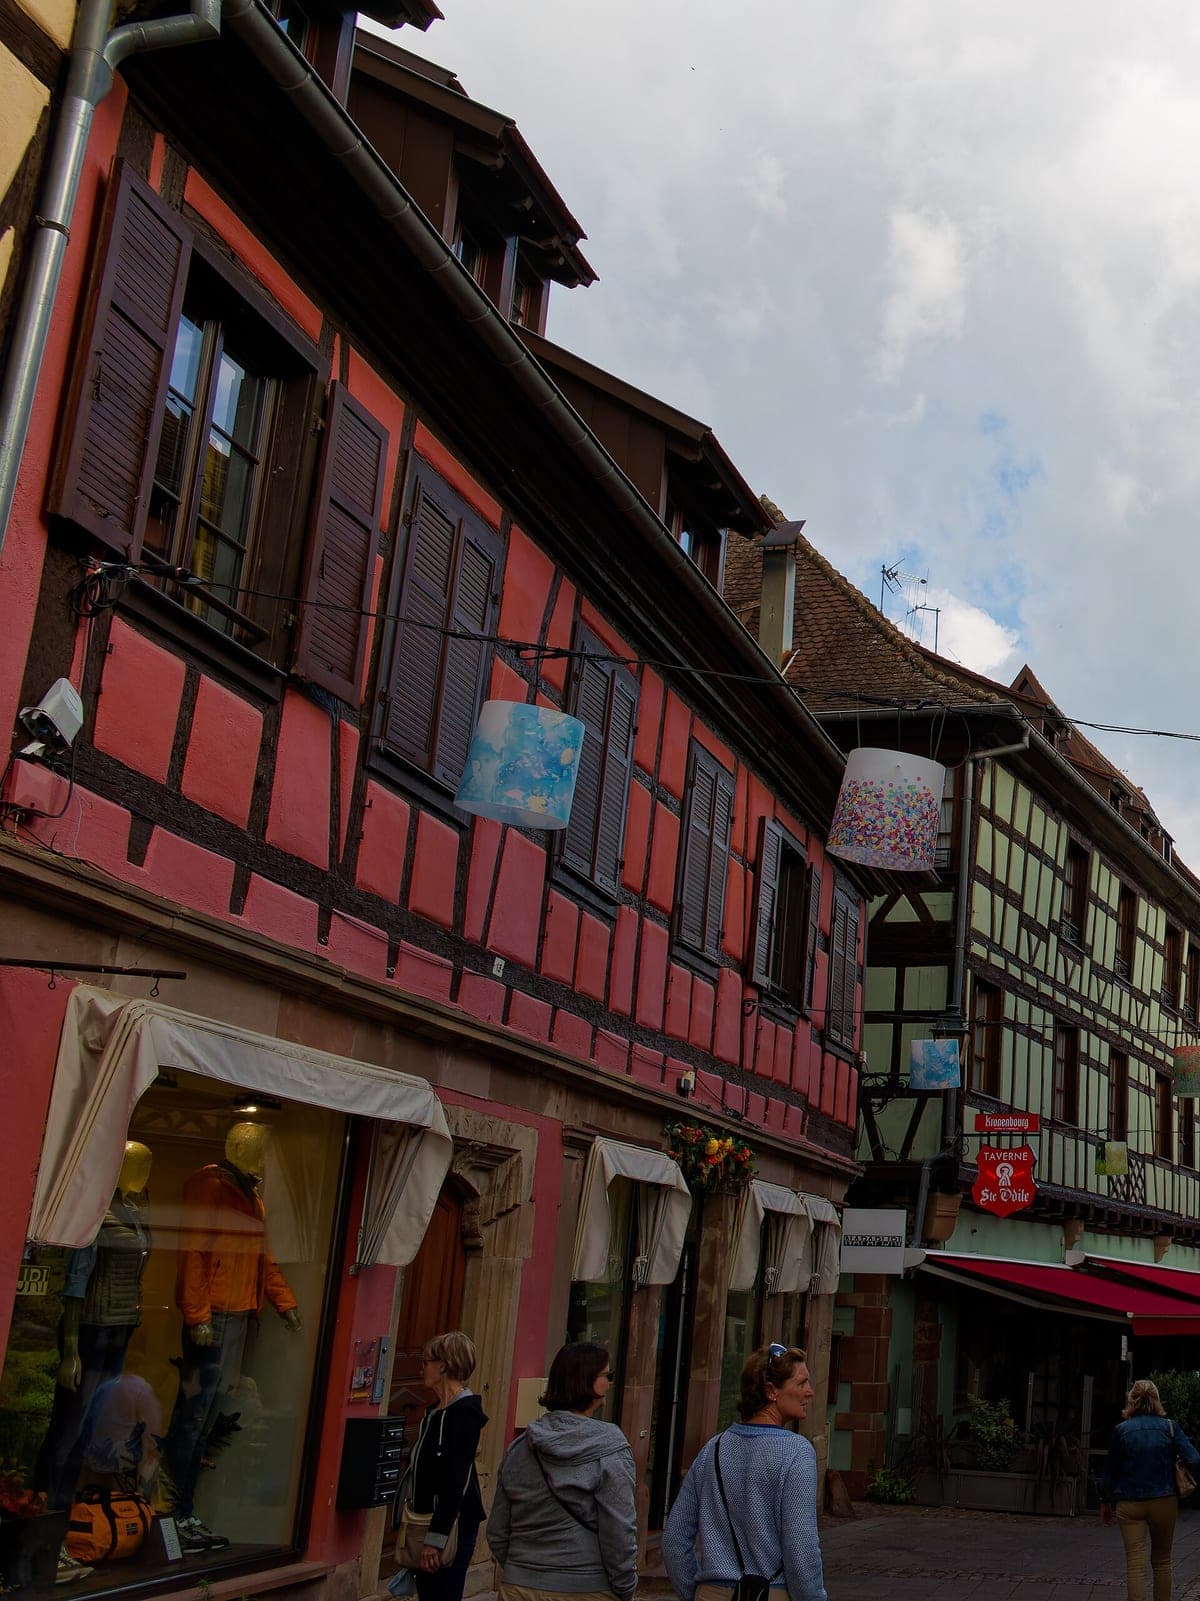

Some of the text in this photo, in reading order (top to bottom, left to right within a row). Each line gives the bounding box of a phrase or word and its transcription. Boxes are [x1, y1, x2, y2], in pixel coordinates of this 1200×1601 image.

[985, 1115, 1029, 1129] Kronenbourg
[983, 1152, 1028, 1160] TAVERNE
[980, 1188, 1029, 1205] Ste Odile
